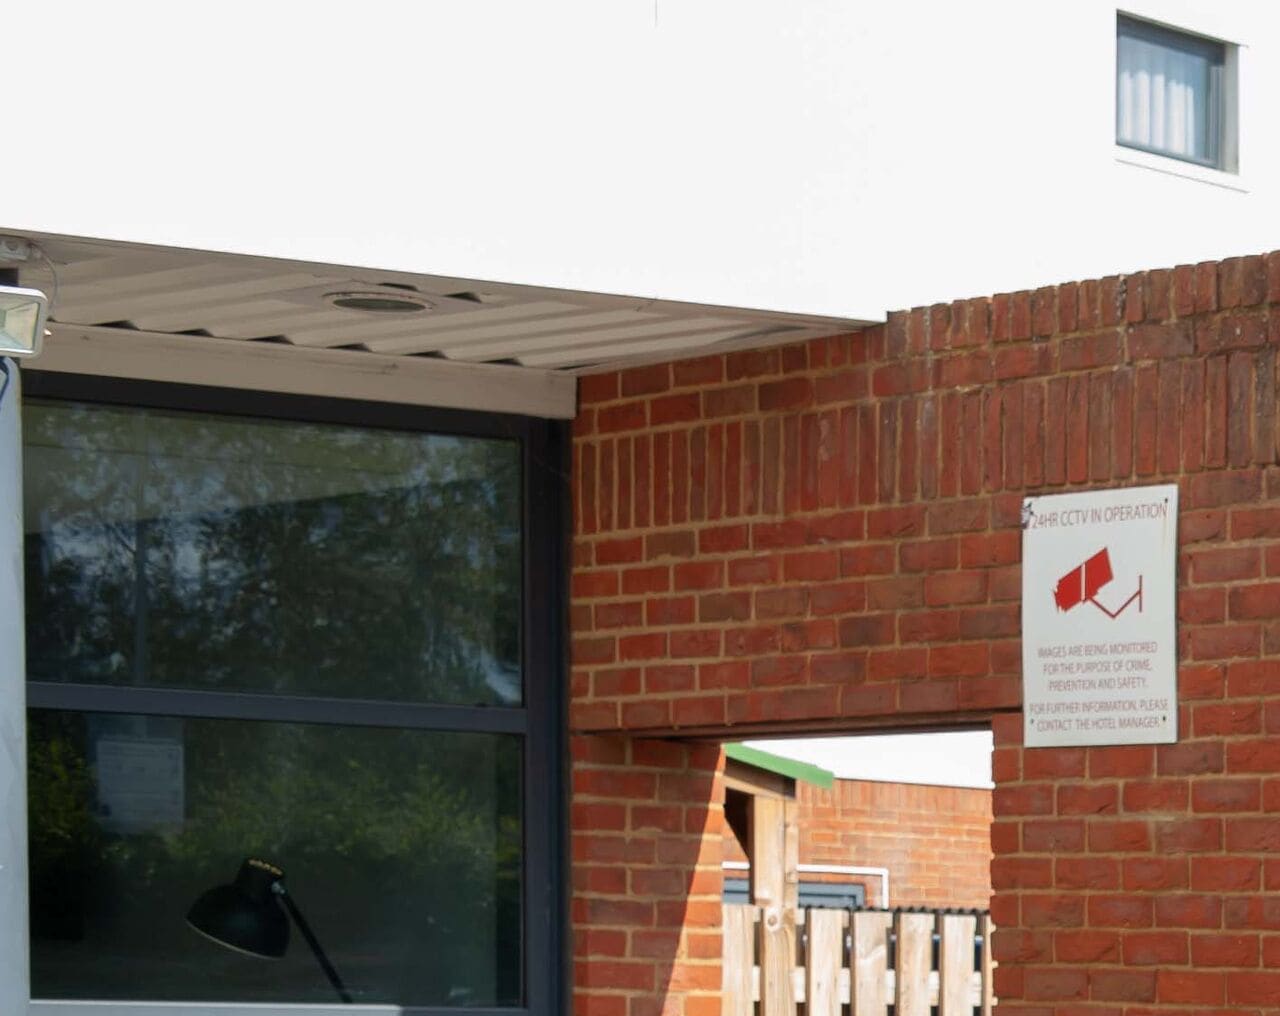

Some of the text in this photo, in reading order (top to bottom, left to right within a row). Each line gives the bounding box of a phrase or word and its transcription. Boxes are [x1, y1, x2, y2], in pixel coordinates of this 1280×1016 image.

[1032, 503, 1166, 528] 24HR CCTV IN OPERATION
[1038, 642, 1158, 658] IMAGES ARE BEING MONITORED
[1044, 664, 1058, 674] FOR
[1061, 663, 1074, 673] THE
[1076, 661, 1110, 672] PURPOSE
[1114, 661, 1122, 671] OF
[1048, 679, 1096, 691] PREVENTION
[1098, 678, 1116, 689] AND
